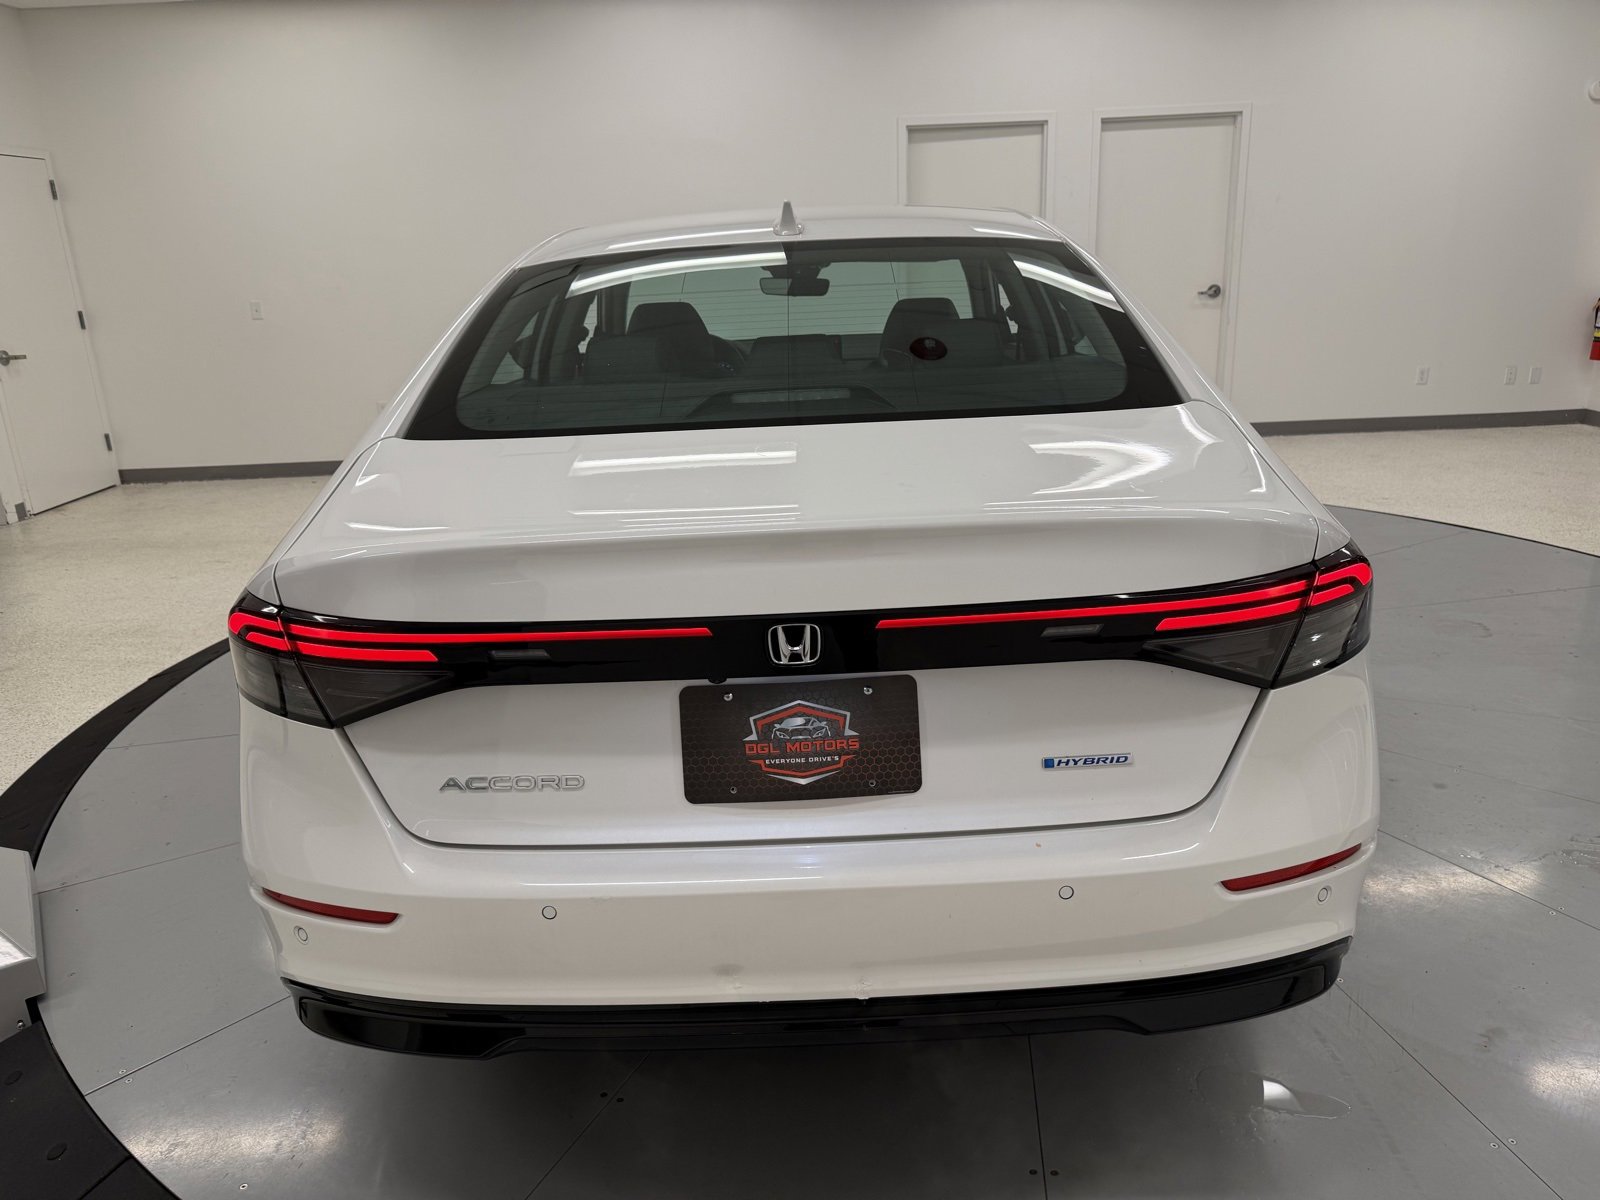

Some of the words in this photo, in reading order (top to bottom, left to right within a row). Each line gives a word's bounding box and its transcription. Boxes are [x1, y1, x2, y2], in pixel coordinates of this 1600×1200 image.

[785, 738, 860, 753] MOTORS
[808, 755, 839, 763] DRIVE'S
[1056, 755, 1129, 767] HYBRID
[439, 774, 585, 792] ACCORD
